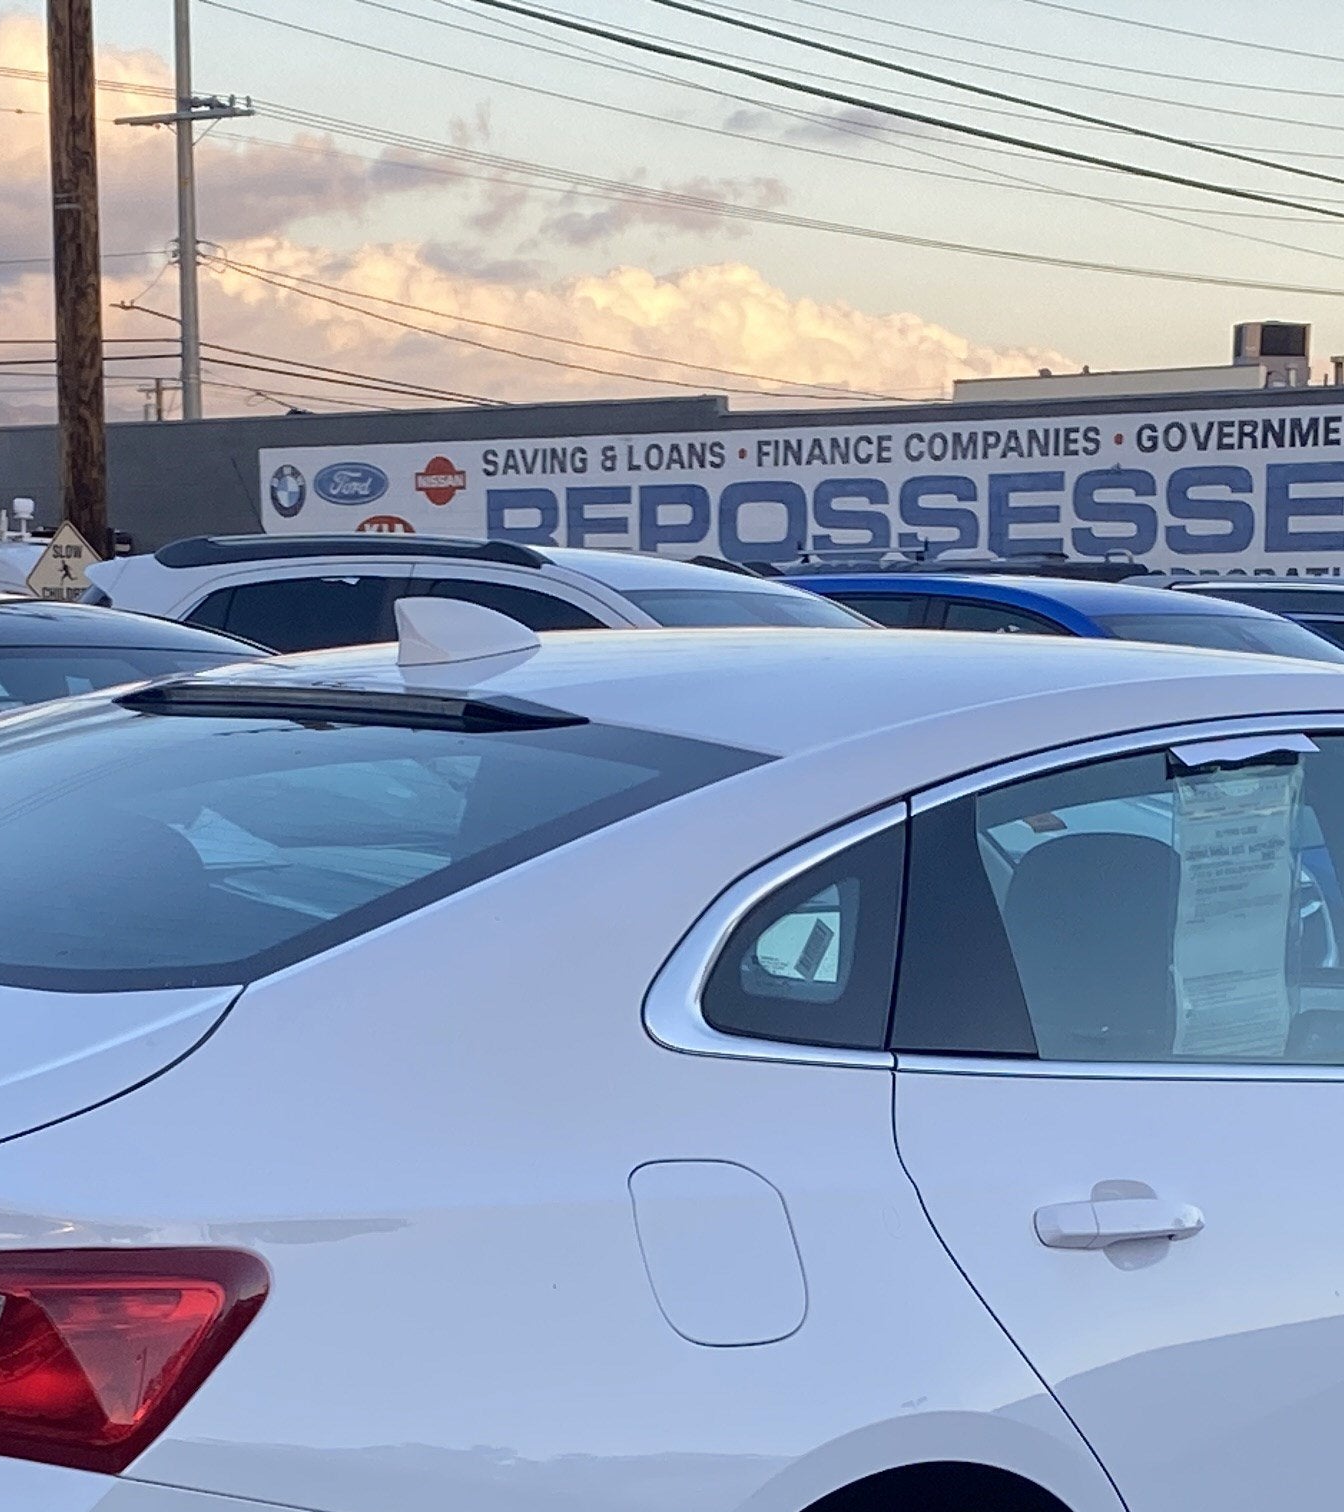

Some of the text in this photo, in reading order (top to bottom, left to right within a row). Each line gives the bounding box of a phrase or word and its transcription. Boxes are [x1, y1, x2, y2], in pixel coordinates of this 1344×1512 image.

[482, 445, 588, 476] SAVING
[601, 445, 617, 472] &
[627, 440, 726, 471] LOANS
[756, 435, 892, 467] FINANCE
[905, 426, 1102, 462] COMPANIES
[329, 470, 373, 496] Ford
[53, 545, 82, 558] SLOW
